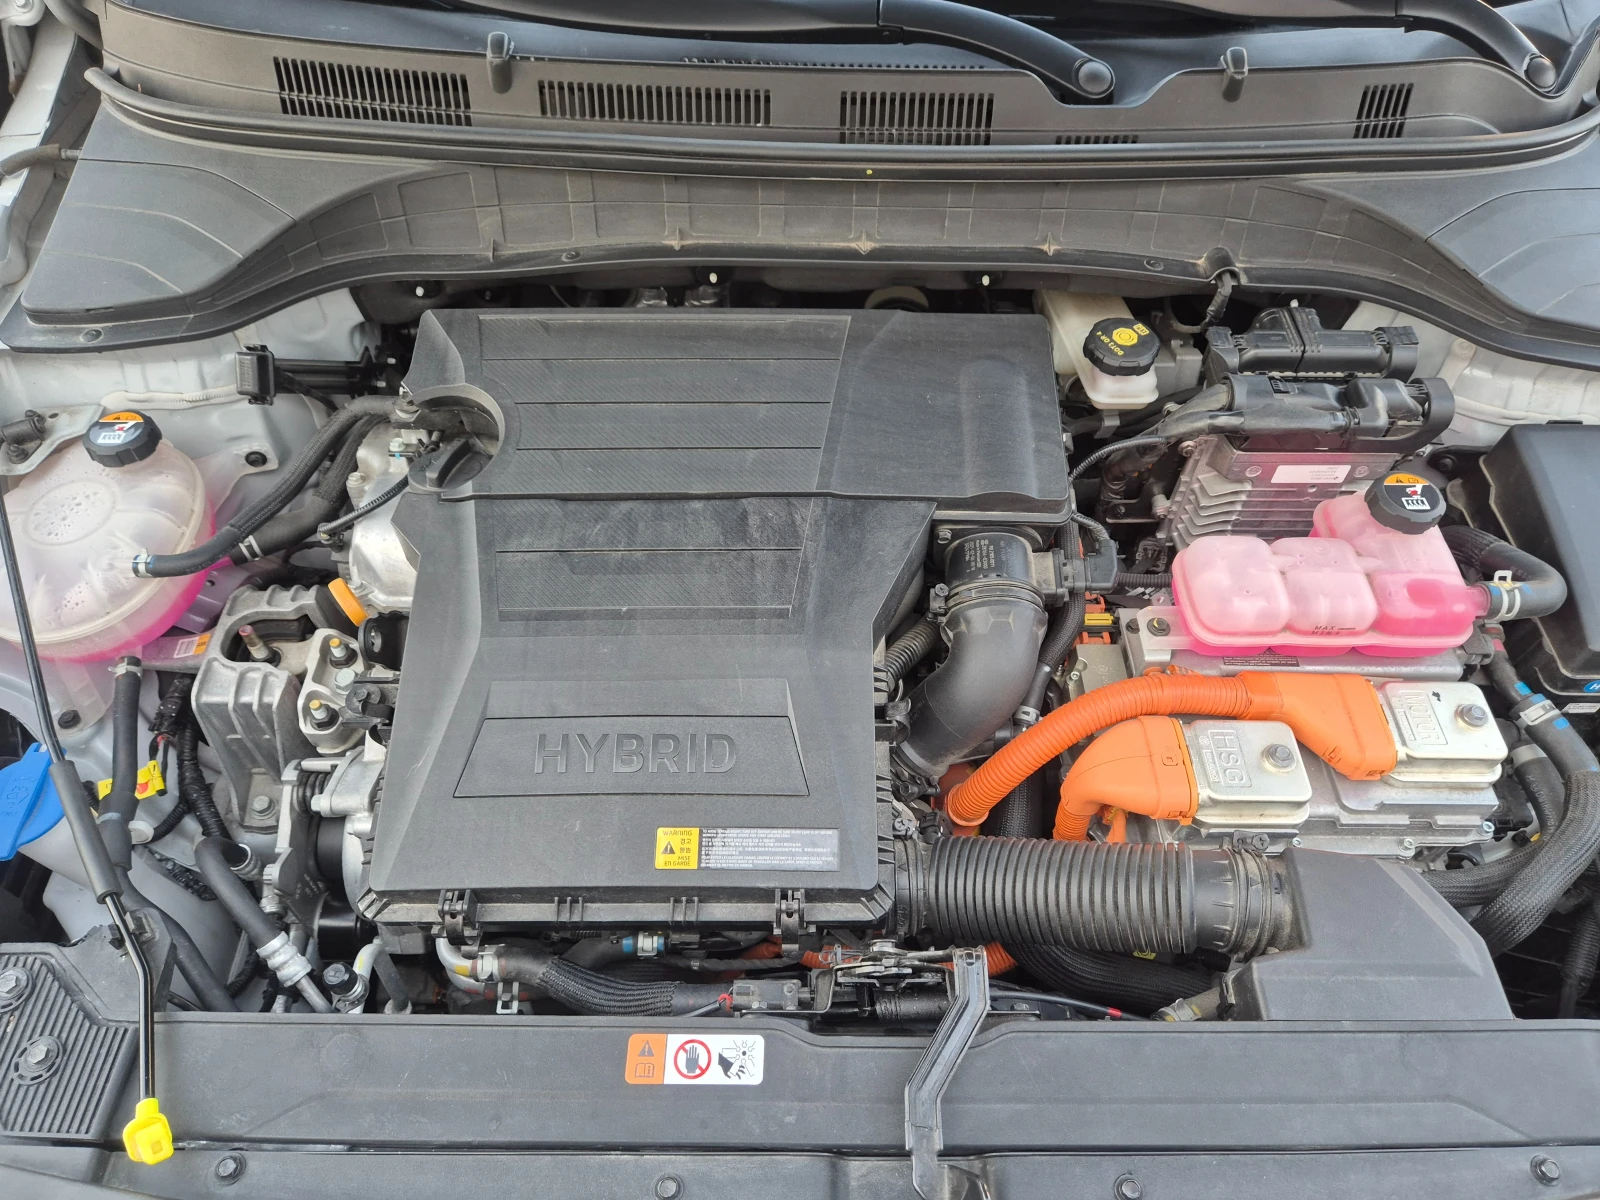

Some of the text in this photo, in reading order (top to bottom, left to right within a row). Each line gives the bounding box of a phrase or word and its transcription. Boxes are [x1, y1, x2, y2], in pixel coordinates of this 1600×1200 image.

[1108, 342, 1124, 355] DOT3
[534, 733, 737, 774] HYBRID
[1213, 735, 1246, 785] HSG
[663, 829, 692, 837] WARNING
